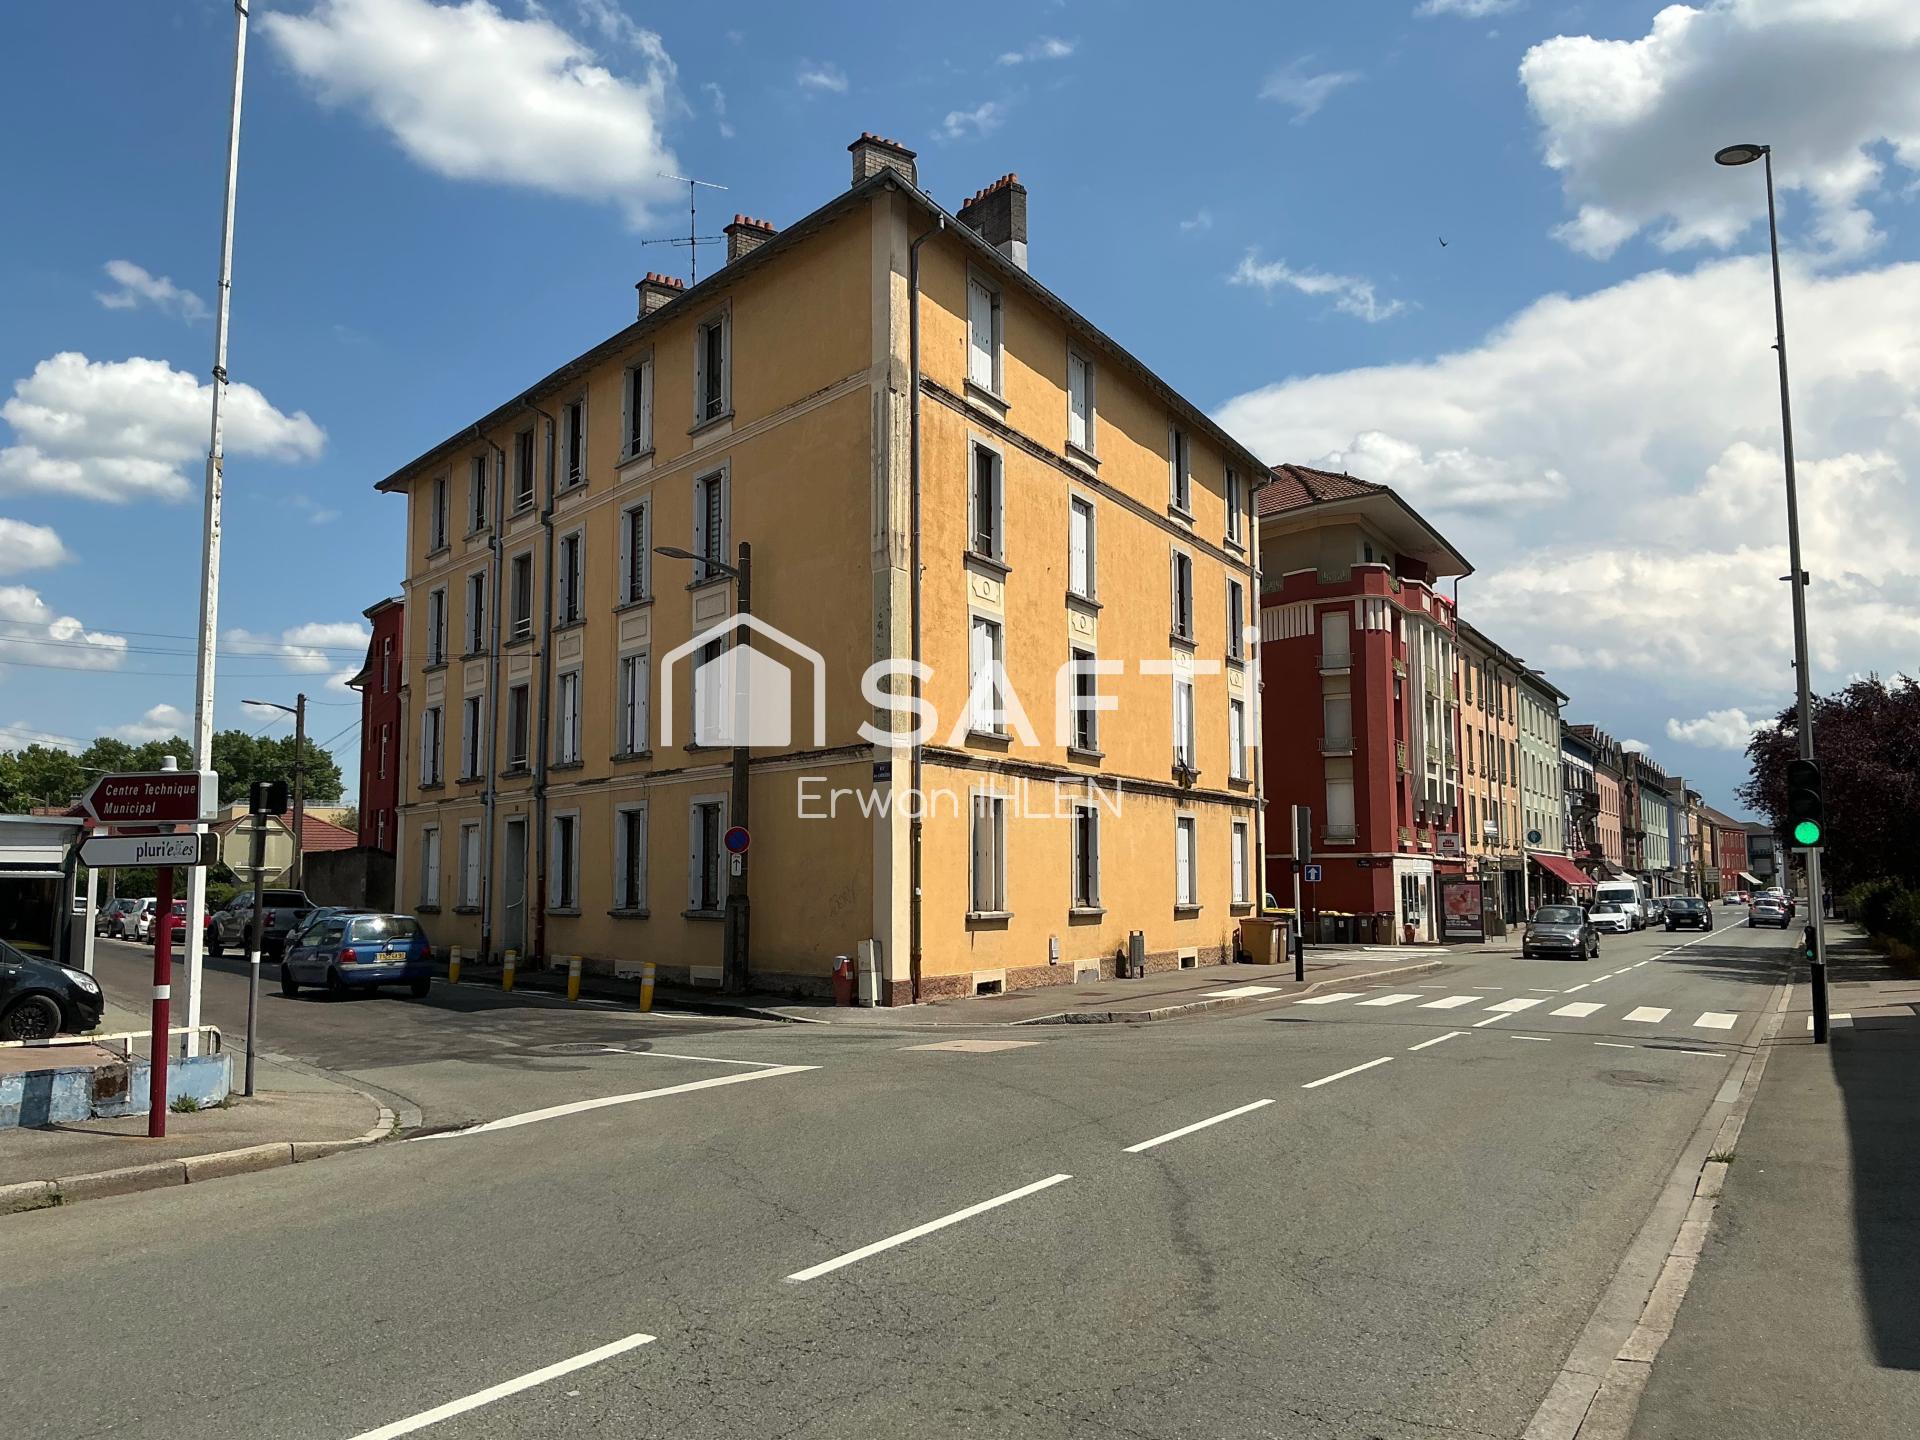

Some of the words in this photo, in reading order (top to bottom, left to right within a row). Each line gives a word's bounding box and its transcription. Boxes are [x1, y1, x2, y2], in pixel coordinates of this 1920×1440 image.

[106, 784, 139, 796] Centre
[145, 783, 196, 798] Technique
[104, 802, 156, 816] Municipal
